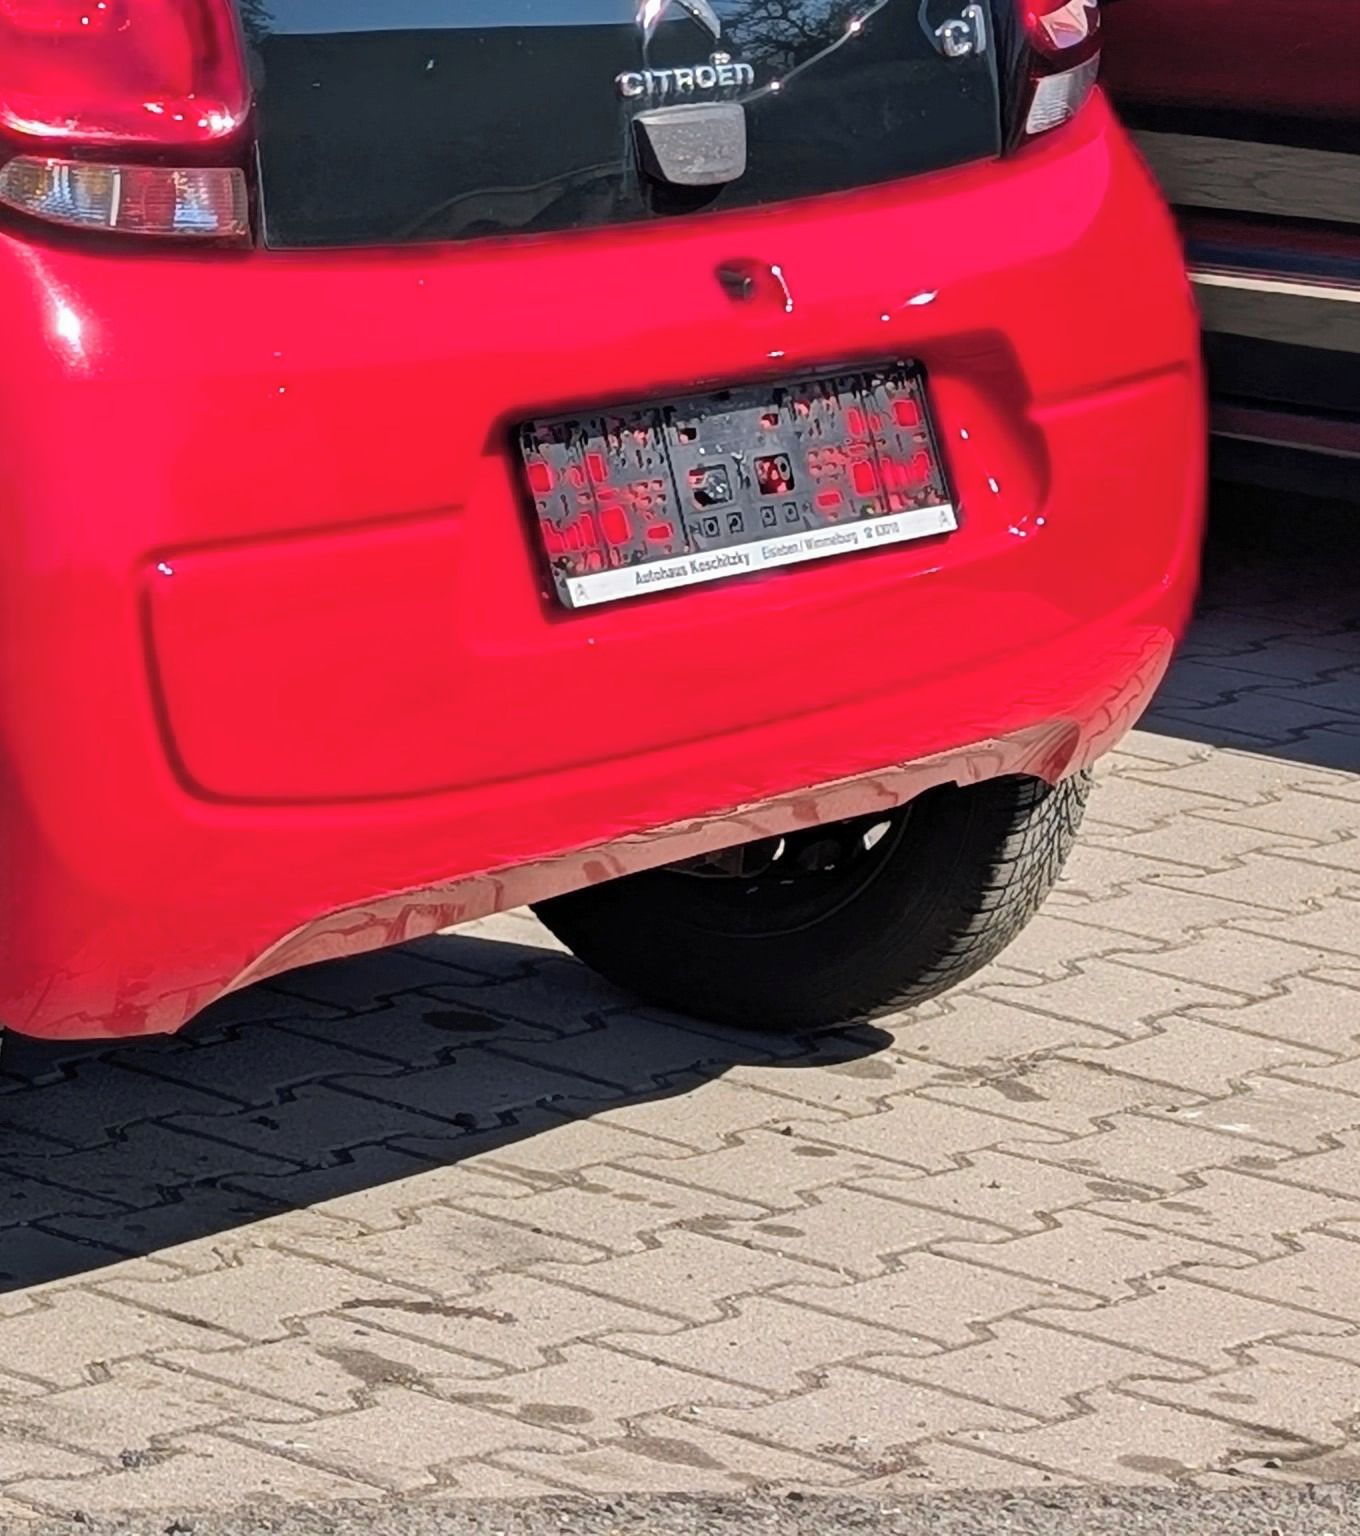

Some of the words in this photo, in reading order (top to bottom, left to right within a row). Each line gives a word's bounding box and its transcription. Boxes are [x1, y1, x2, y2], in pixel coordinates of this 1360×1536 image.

[934, 4, 987, 57] C1
[614, 51, 755, 97] CITROËN
[635, 564, 689, 585] Autohaus
